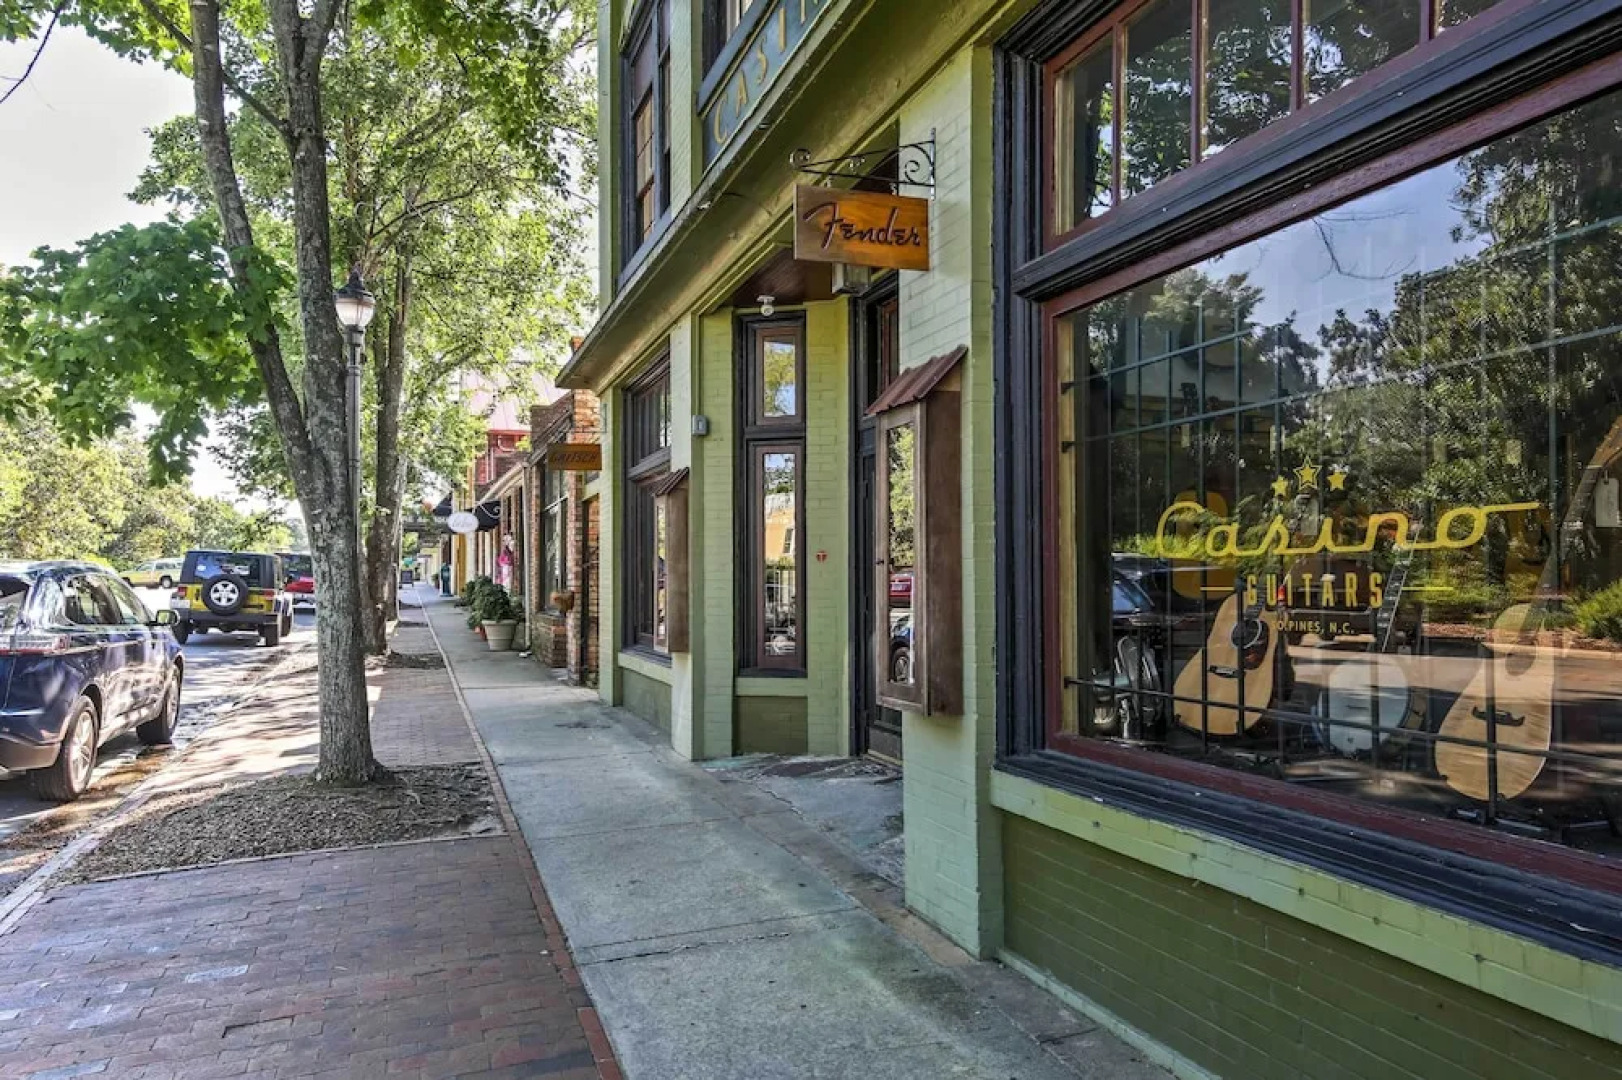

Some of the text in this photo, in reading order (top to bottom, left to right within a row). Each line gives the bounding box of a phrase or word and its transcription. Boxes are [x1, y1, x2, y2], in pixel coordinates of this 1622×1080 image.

[802, 201, 921, 250] Fender
[1156, 501, 1540, 558] Casino
[1247, 572, 1383, 608] GUITARS
